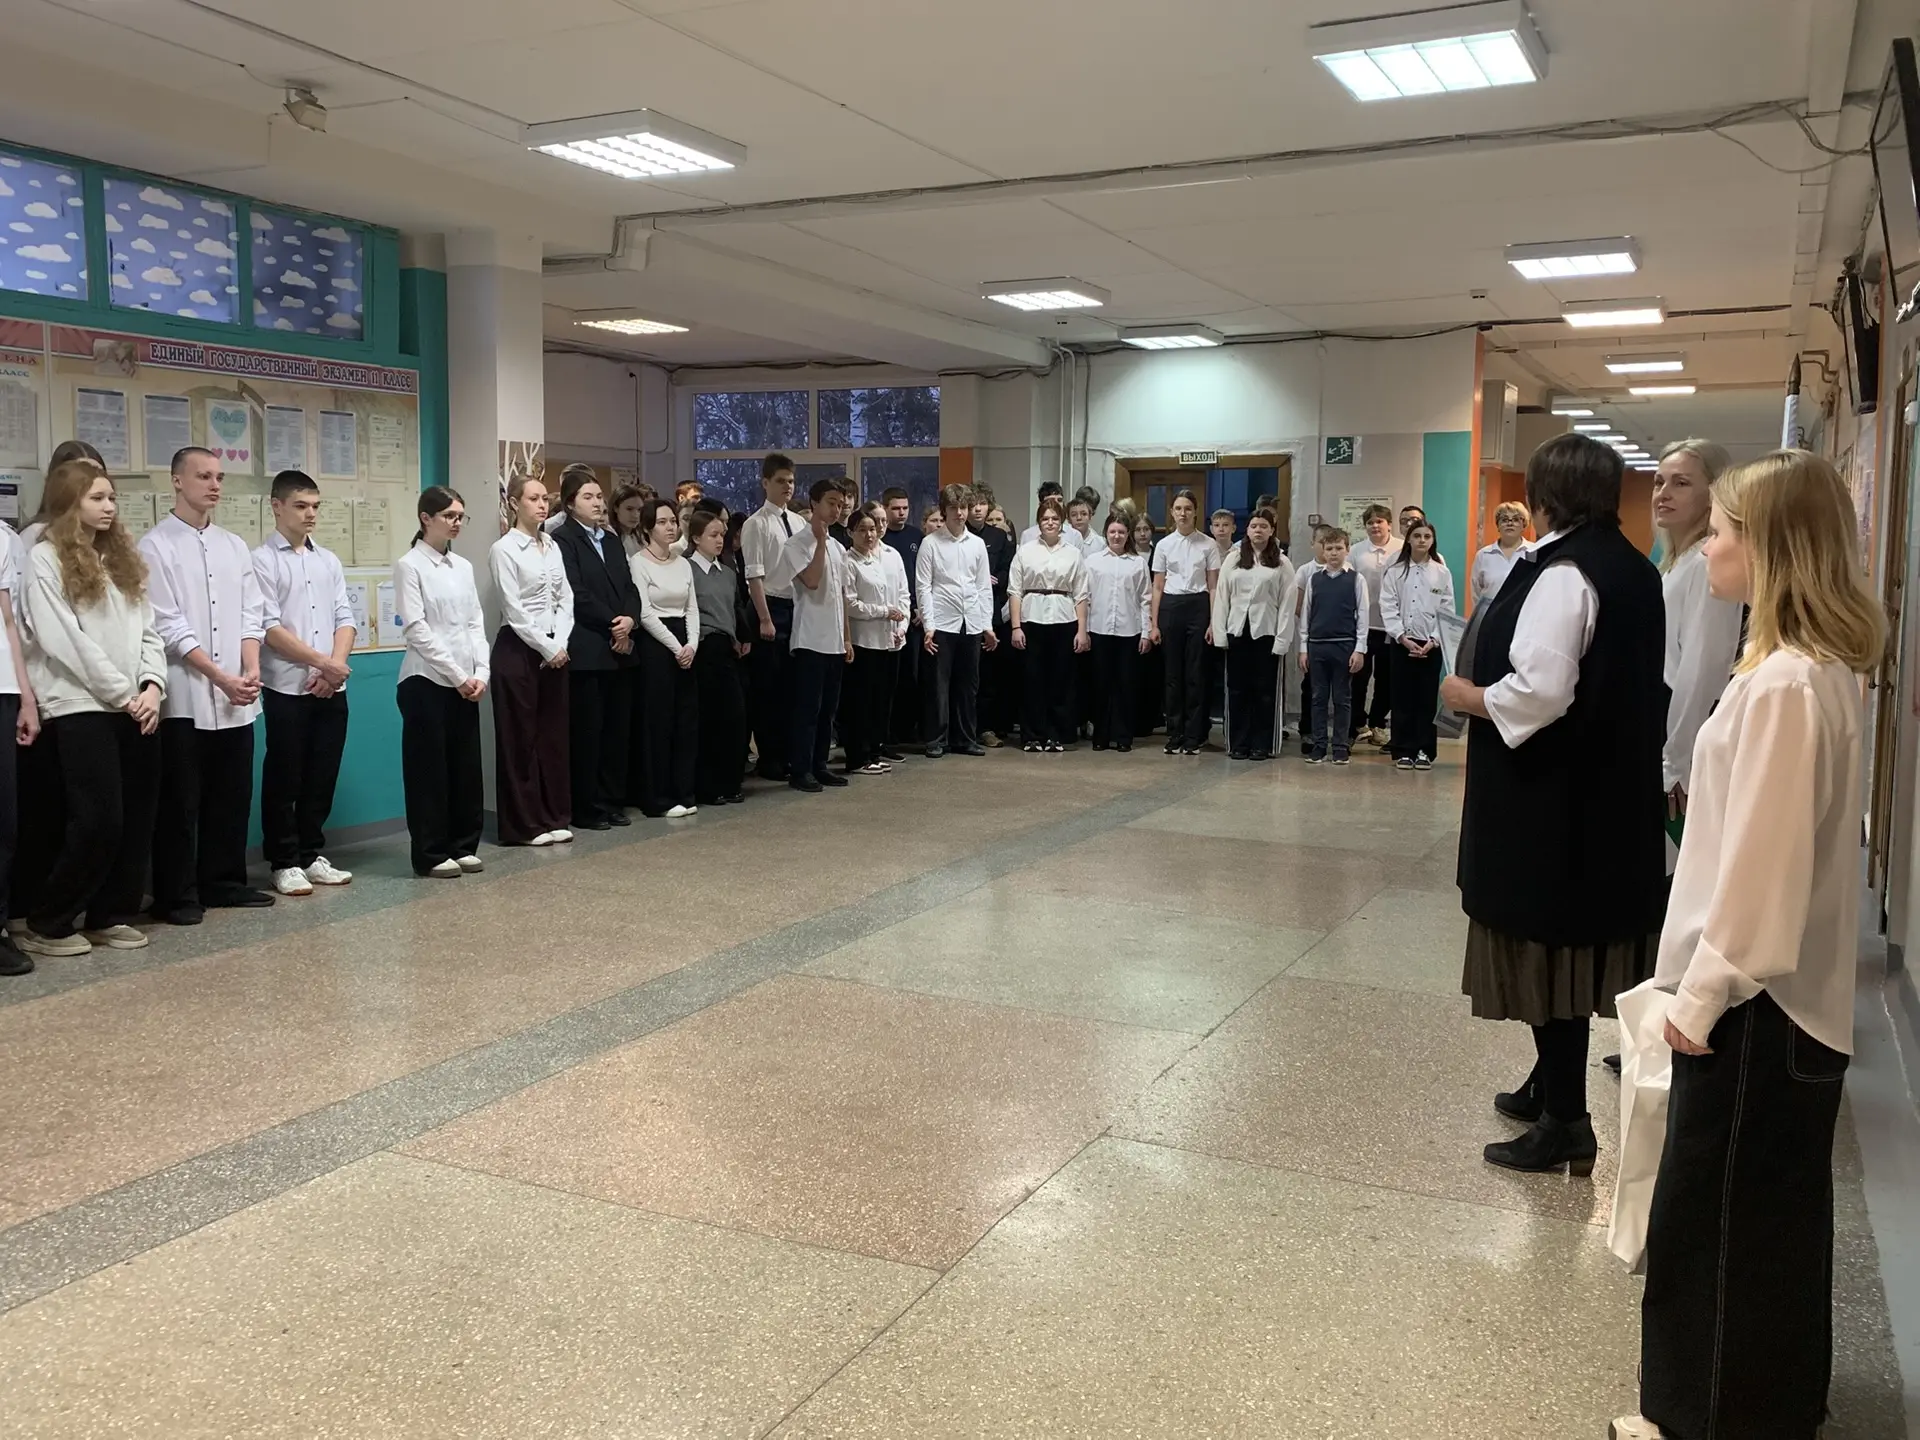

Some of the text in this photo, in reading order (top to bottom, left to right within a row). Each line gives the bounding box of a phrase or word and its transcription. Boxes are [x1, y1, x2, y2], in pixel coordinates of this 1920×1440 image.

[150, 343, 412, 389] ЕДИНЫЙ ГОСУДАРСТВЕННЫЙ ЭКЗАМЕН 11 КЛАСС
[1183, 452, 1214, 462] ВЫХОД
